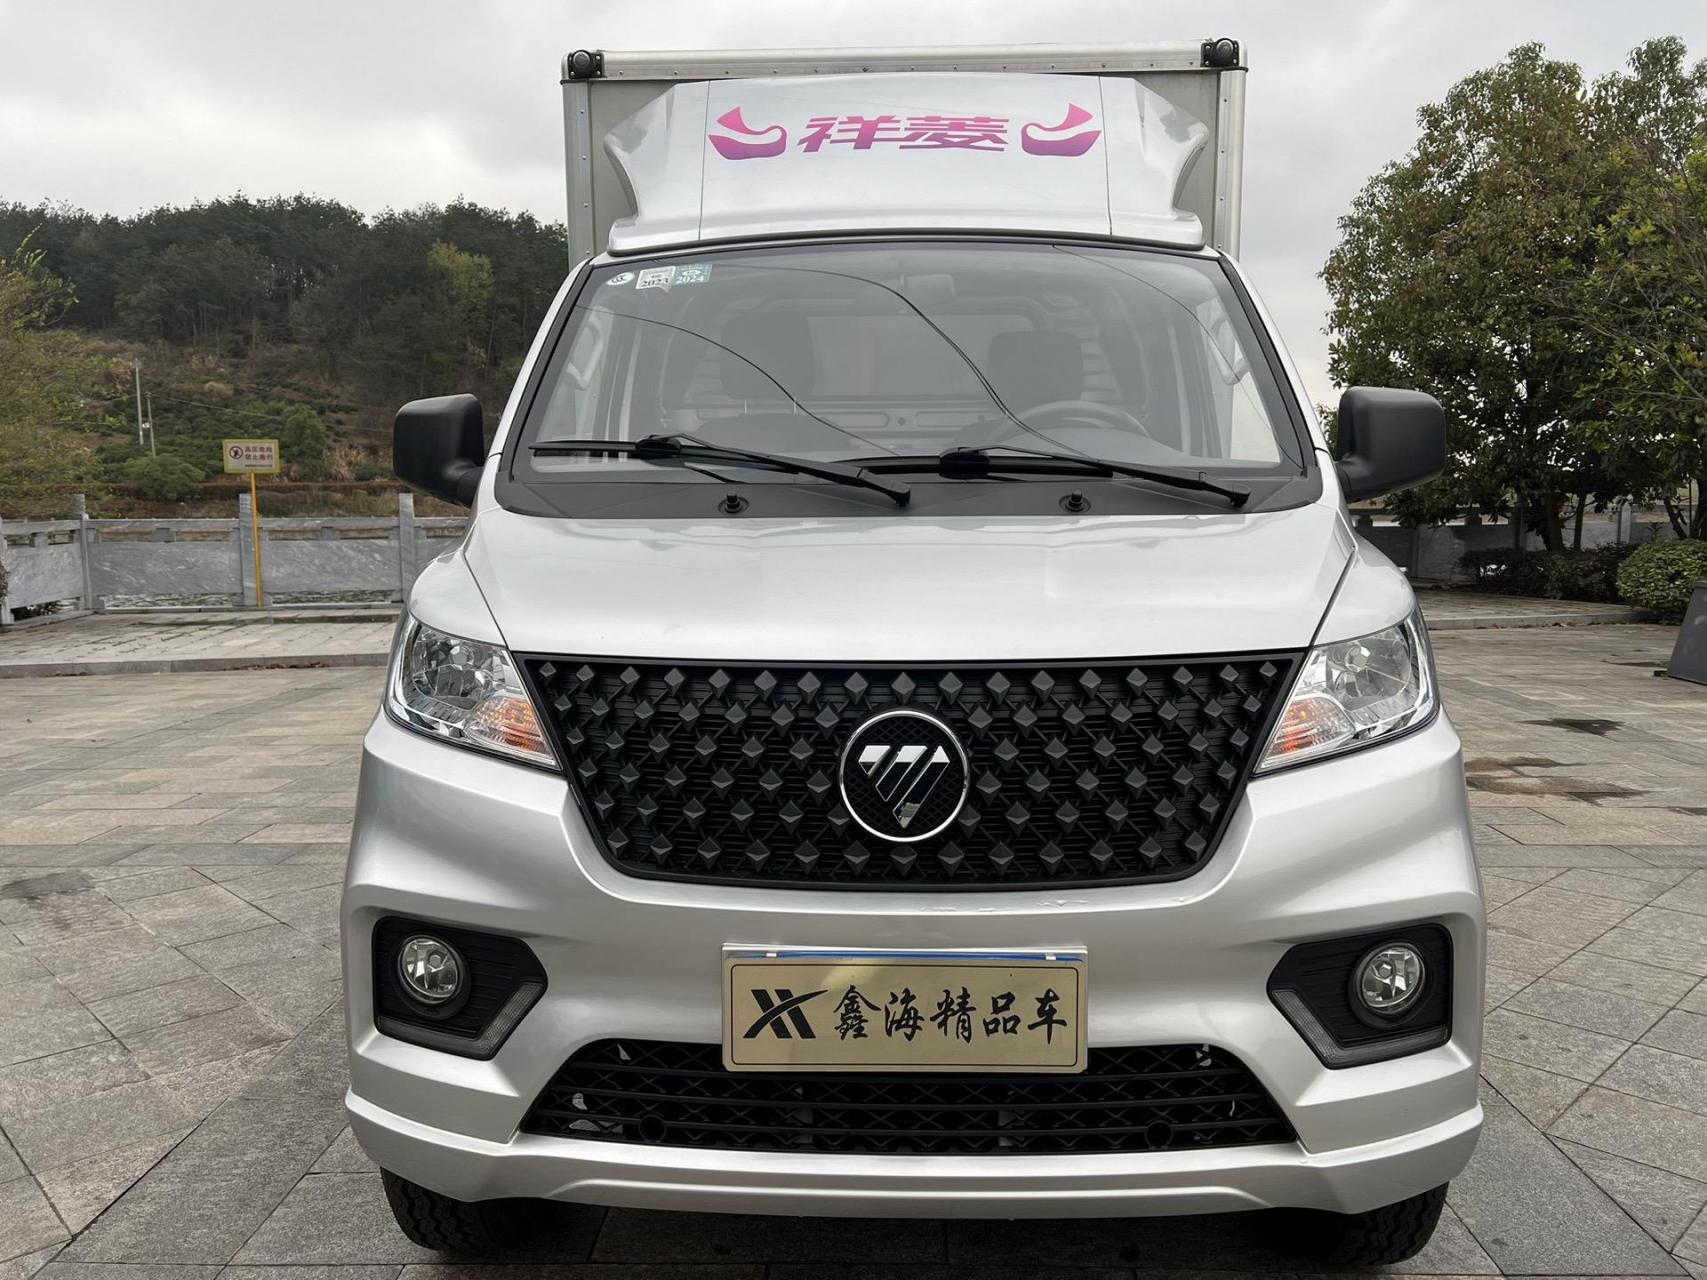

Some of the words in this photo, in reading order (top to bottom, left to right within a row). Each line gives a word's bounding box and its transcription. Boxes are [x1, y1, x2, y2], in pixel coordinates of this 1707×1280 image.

[797, 115, 1010, 153] 祥菱
[641, 277, 669, 287] 2023
[675, 274, 705, 284] 2024
[833, 984, 1068, 1045] 鑫海精品车
